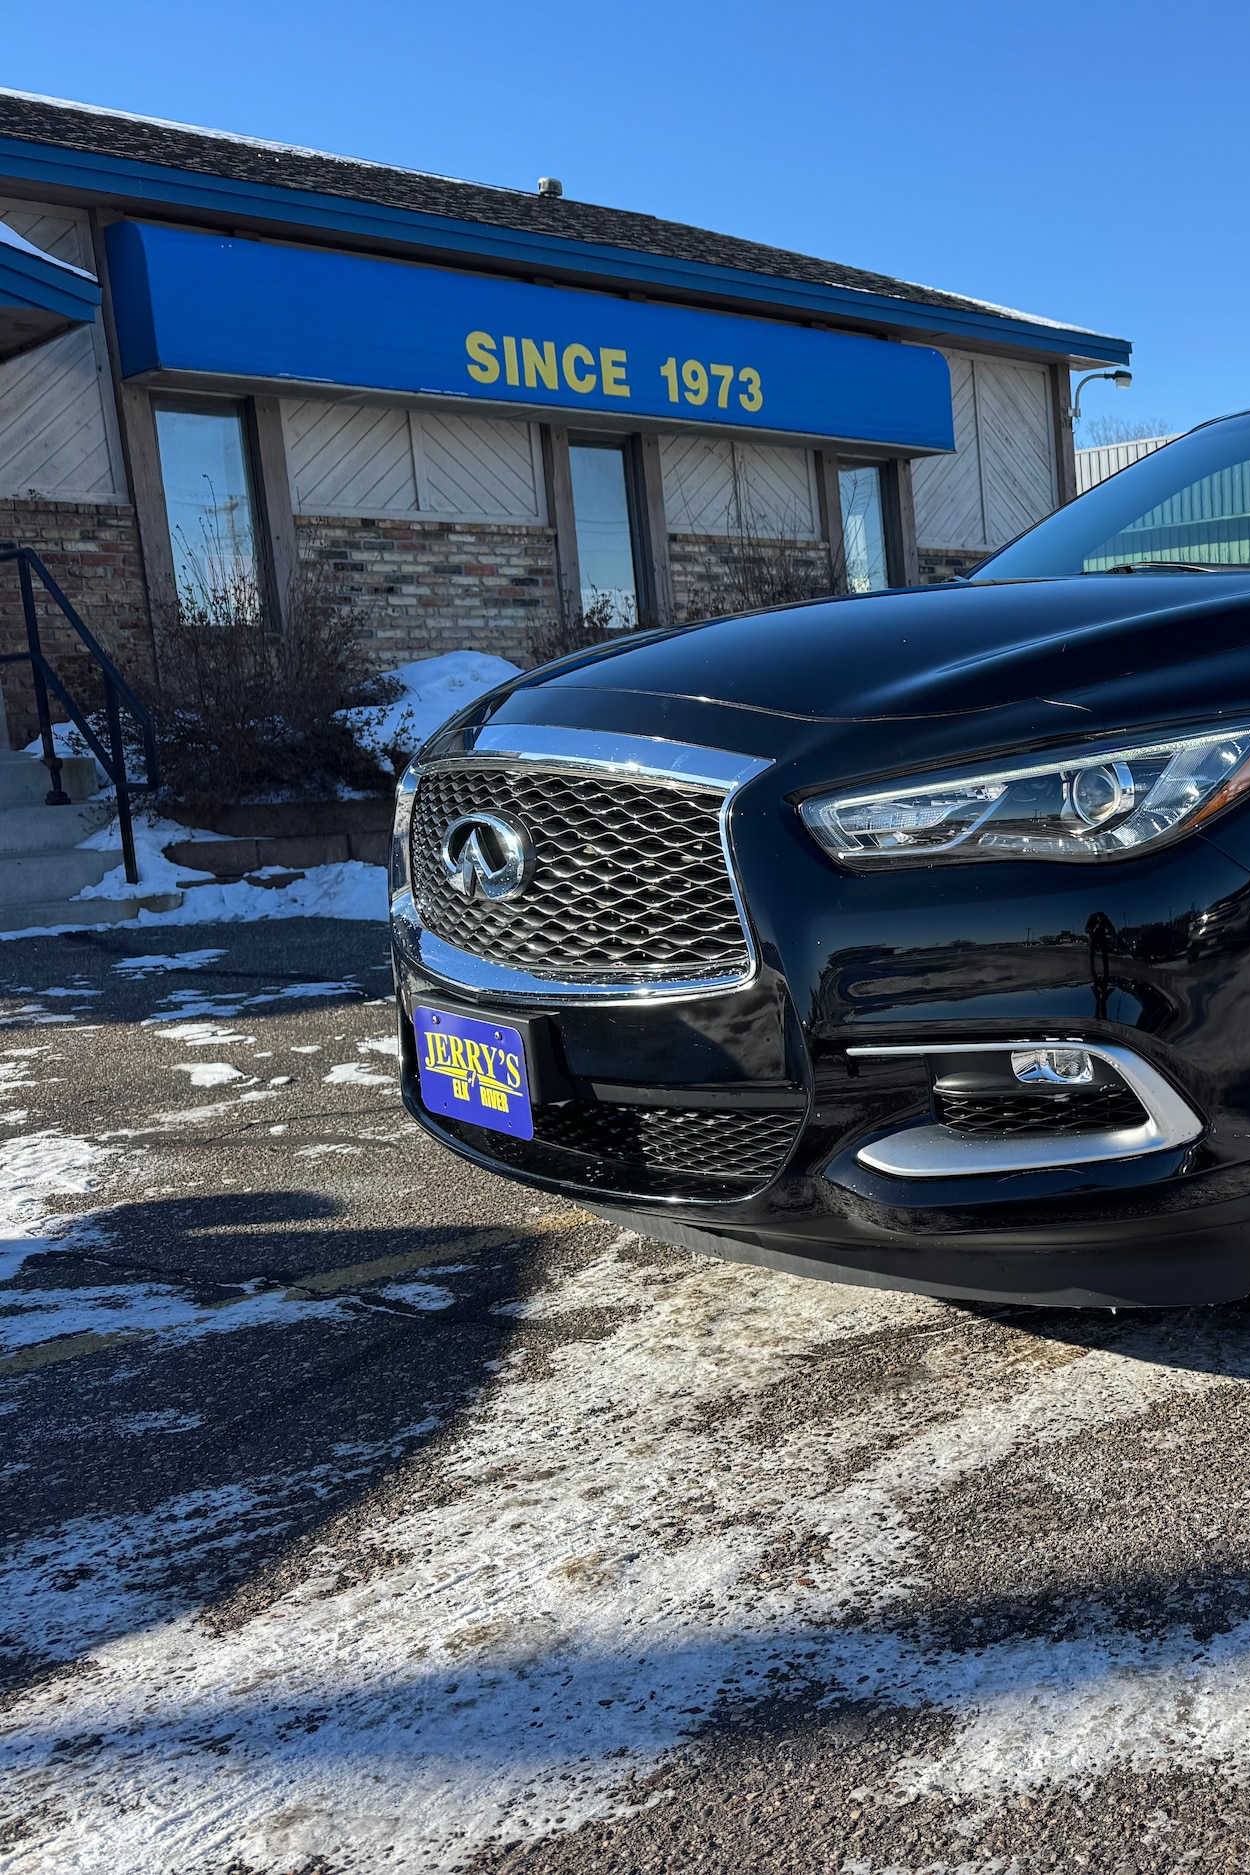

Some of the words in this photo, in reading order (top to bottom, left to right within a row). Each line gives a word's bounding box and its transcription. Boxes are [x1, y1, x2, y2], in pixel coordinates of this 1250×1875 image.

[466, 331, 630, 397] SINCE
[660, 357, 763, 412] 1973
[424, 1031, 521, 1088] JERRY'S
[452, 1078, 470, 1101] ELK
[480, 1086, 509, 1113] RIVER
